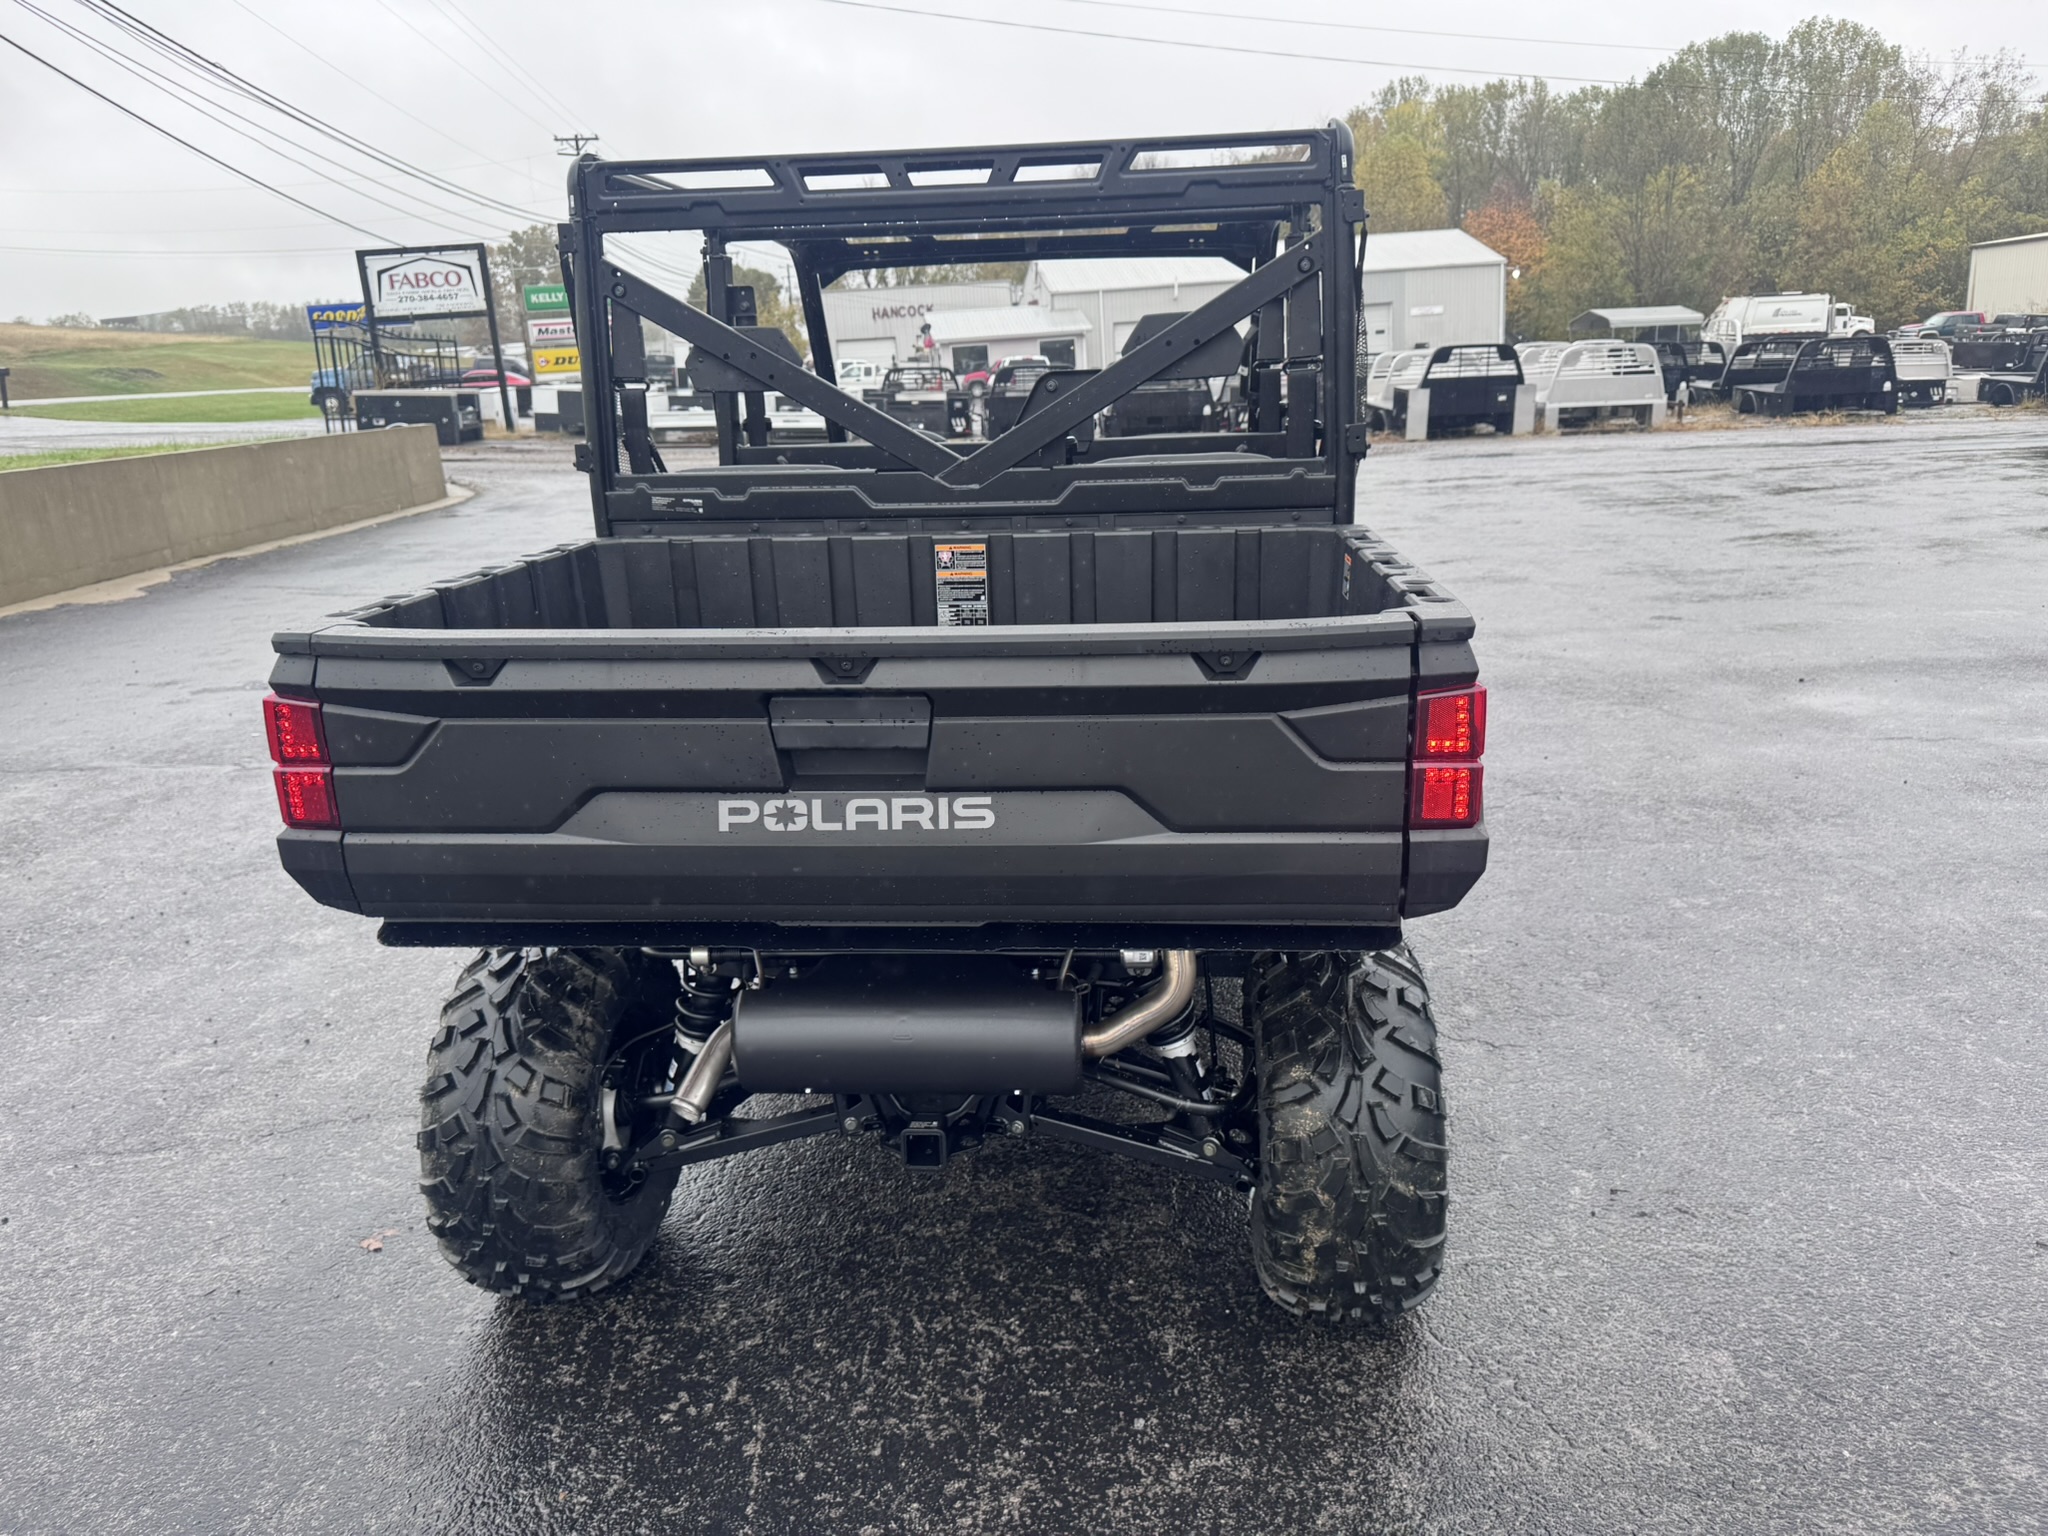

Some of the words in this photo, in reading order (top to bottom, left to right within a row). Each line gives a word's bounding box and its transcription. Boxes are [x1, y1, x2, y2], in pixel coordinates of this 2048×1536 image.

[388, 270, 462, 290] FABCO
[530, 292, 564, 304] KELLY
[872, 303, 934, 321] HANCOCK
[538, 326, 576, 336] Mast
[718, 796, 996, 832] POLARIS
